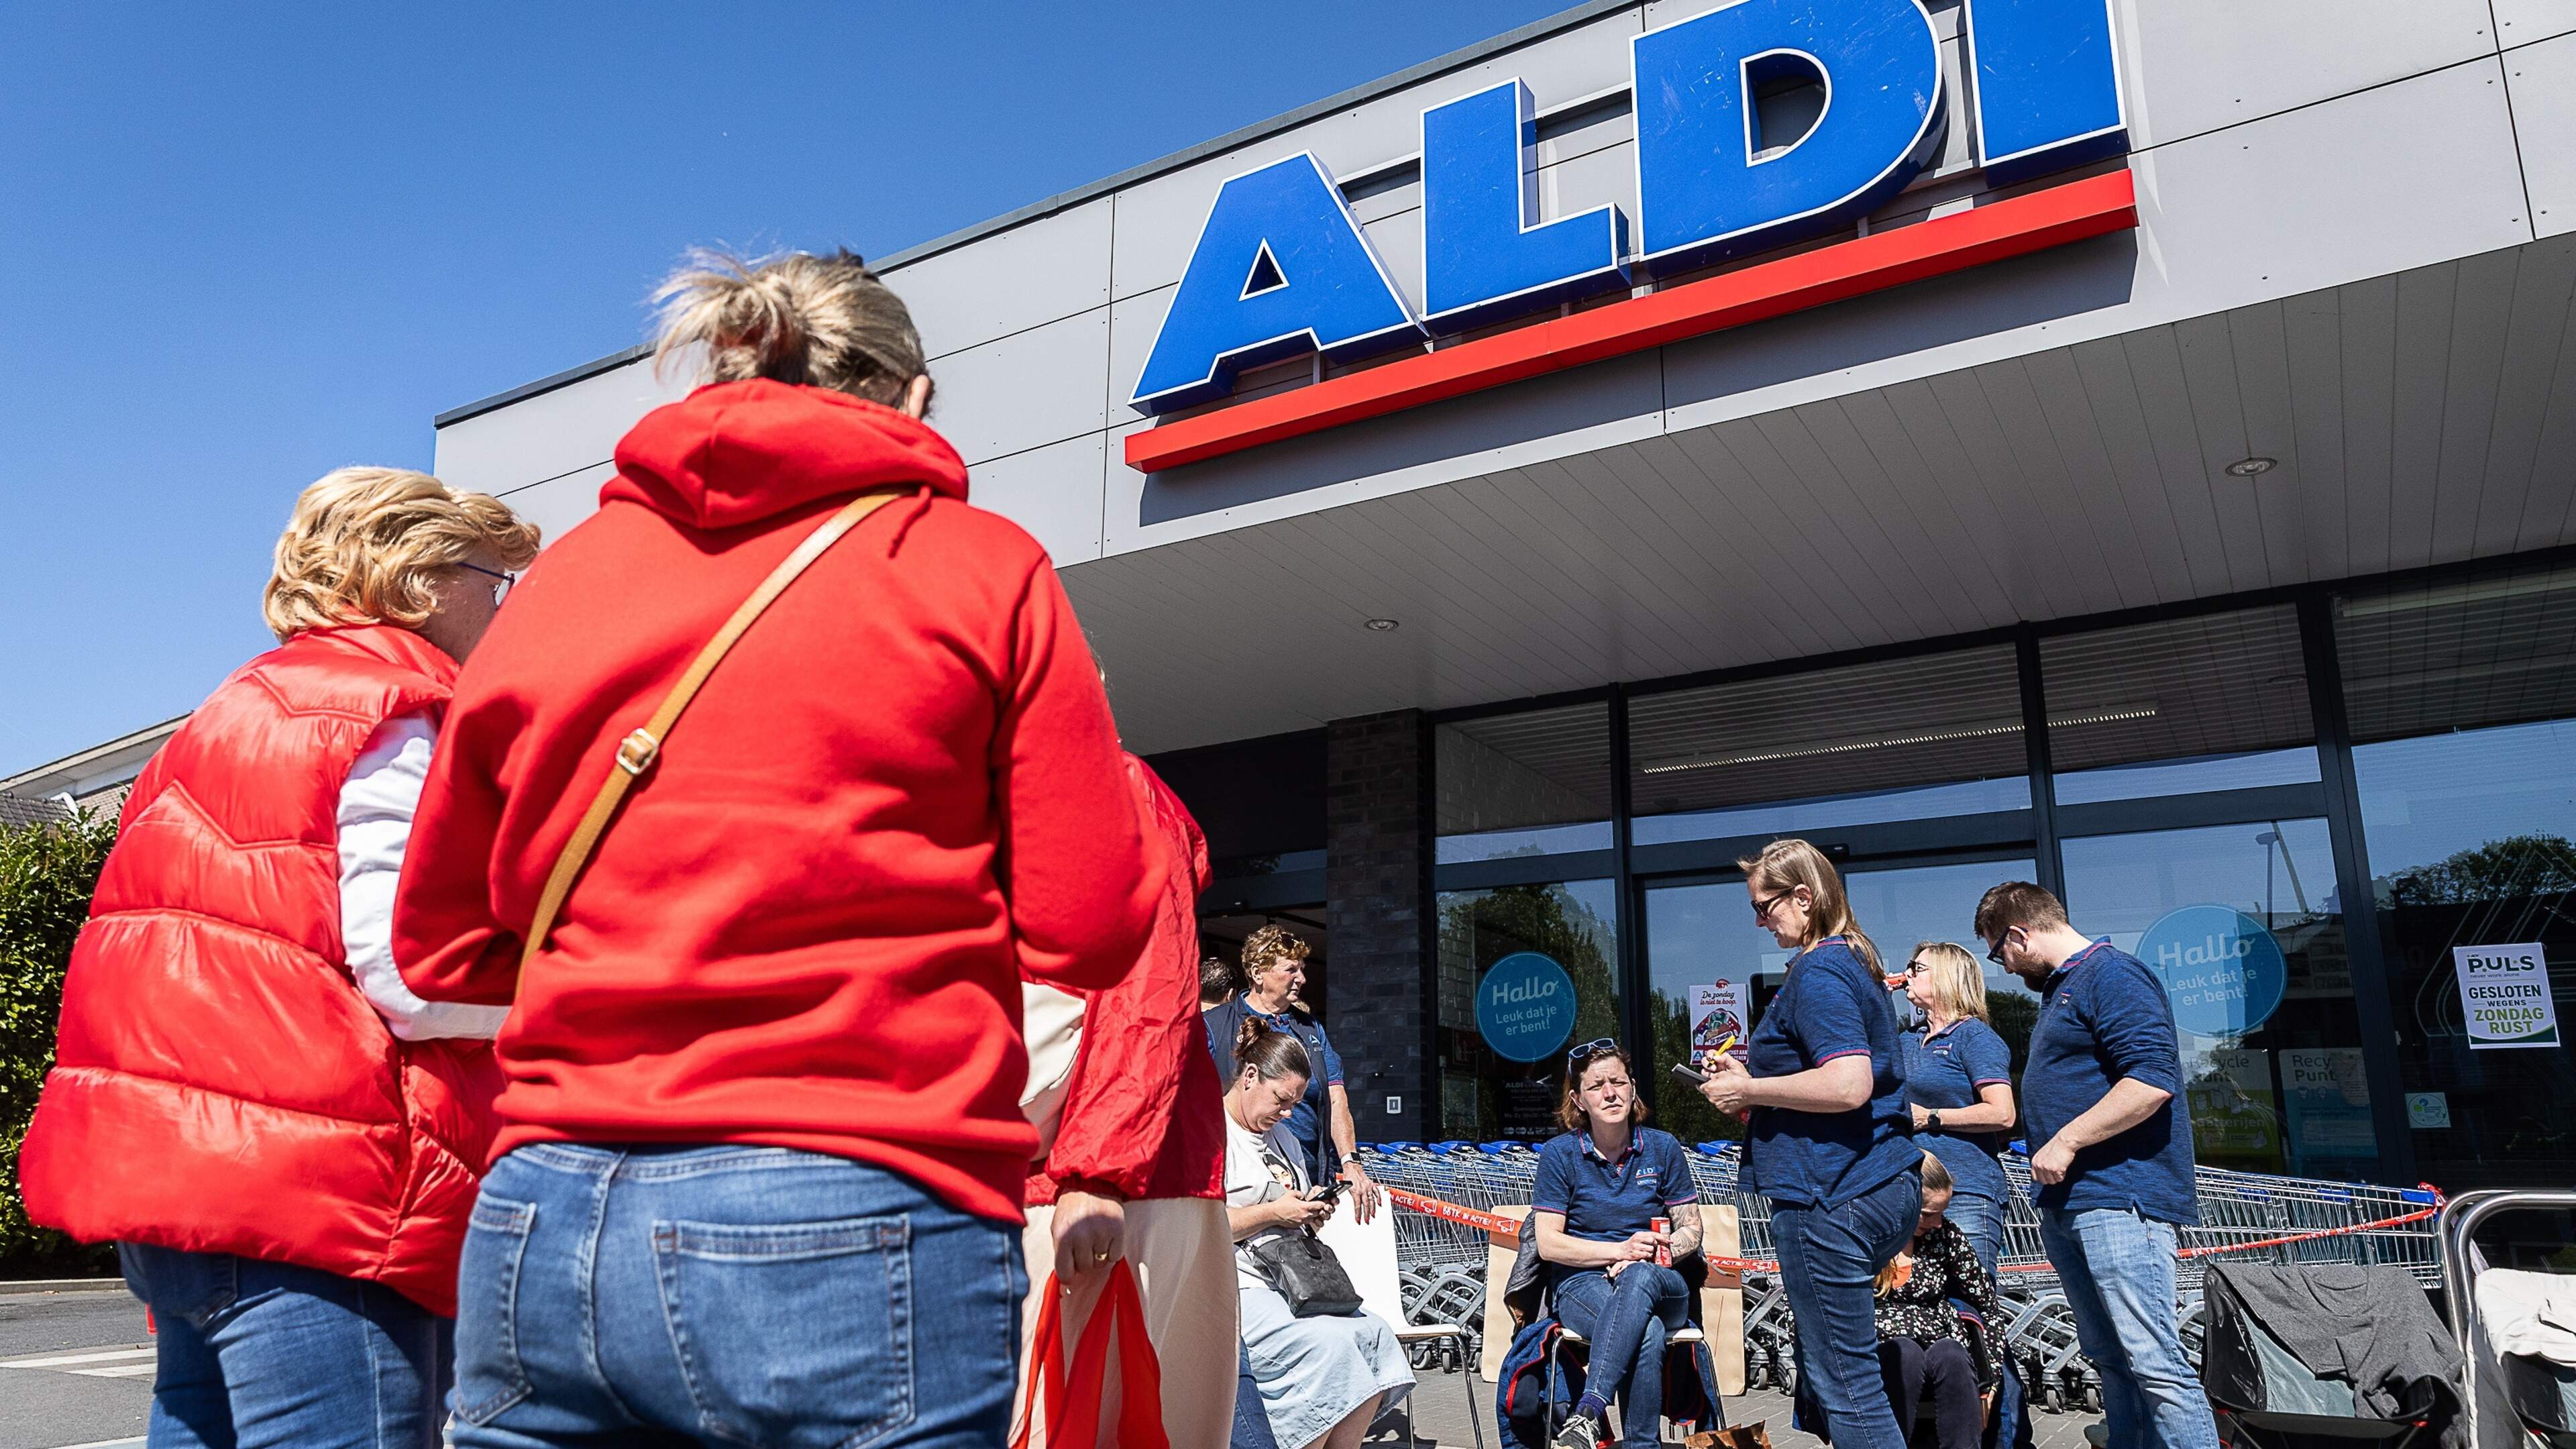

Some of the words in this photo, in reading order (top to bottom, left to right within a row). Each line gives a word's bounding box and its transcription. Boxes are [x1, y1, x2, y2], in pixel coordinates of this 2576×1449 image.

[1130, 0, 2128, 408] ALDI
[2157, 933, 2255, 970] Hallo
[2467, 956, 2535, 973] PULS
[2165, 975, 2208, 992] Leuk
[2211, 970, 2238, 985] dat
[2240, 967, 2257, 984] je
[1493, 976, 1559, 1006] Hallo
[1701, 990, 1711, 999] De
[1711, 991, 1735, 1000] zondag
[2183, 994, 2200, 1006] er
[2204, 985, 2249, 1003] bent!
[2469, 985, 2542, 999] GESLOTEN
[1495, 1010, 1523, 1024] Leuk
[1526, 1006, 1544, 1019] dat
[1546, 1004, 1557, 1018] je
[2473, 1008, 2544, 1022] ZONDAG
[1505, 1026, 1517, 1036] er
[1520, 1019, 1550, 1033] bent!
[2489, 1021, 2533, 1034] RUST
[2292, 1055, 2331, 1070] Recy
[2295, 1069, 2337, 1082] Punt
[1470, 1215, 1492, 1226] ACTIE!
